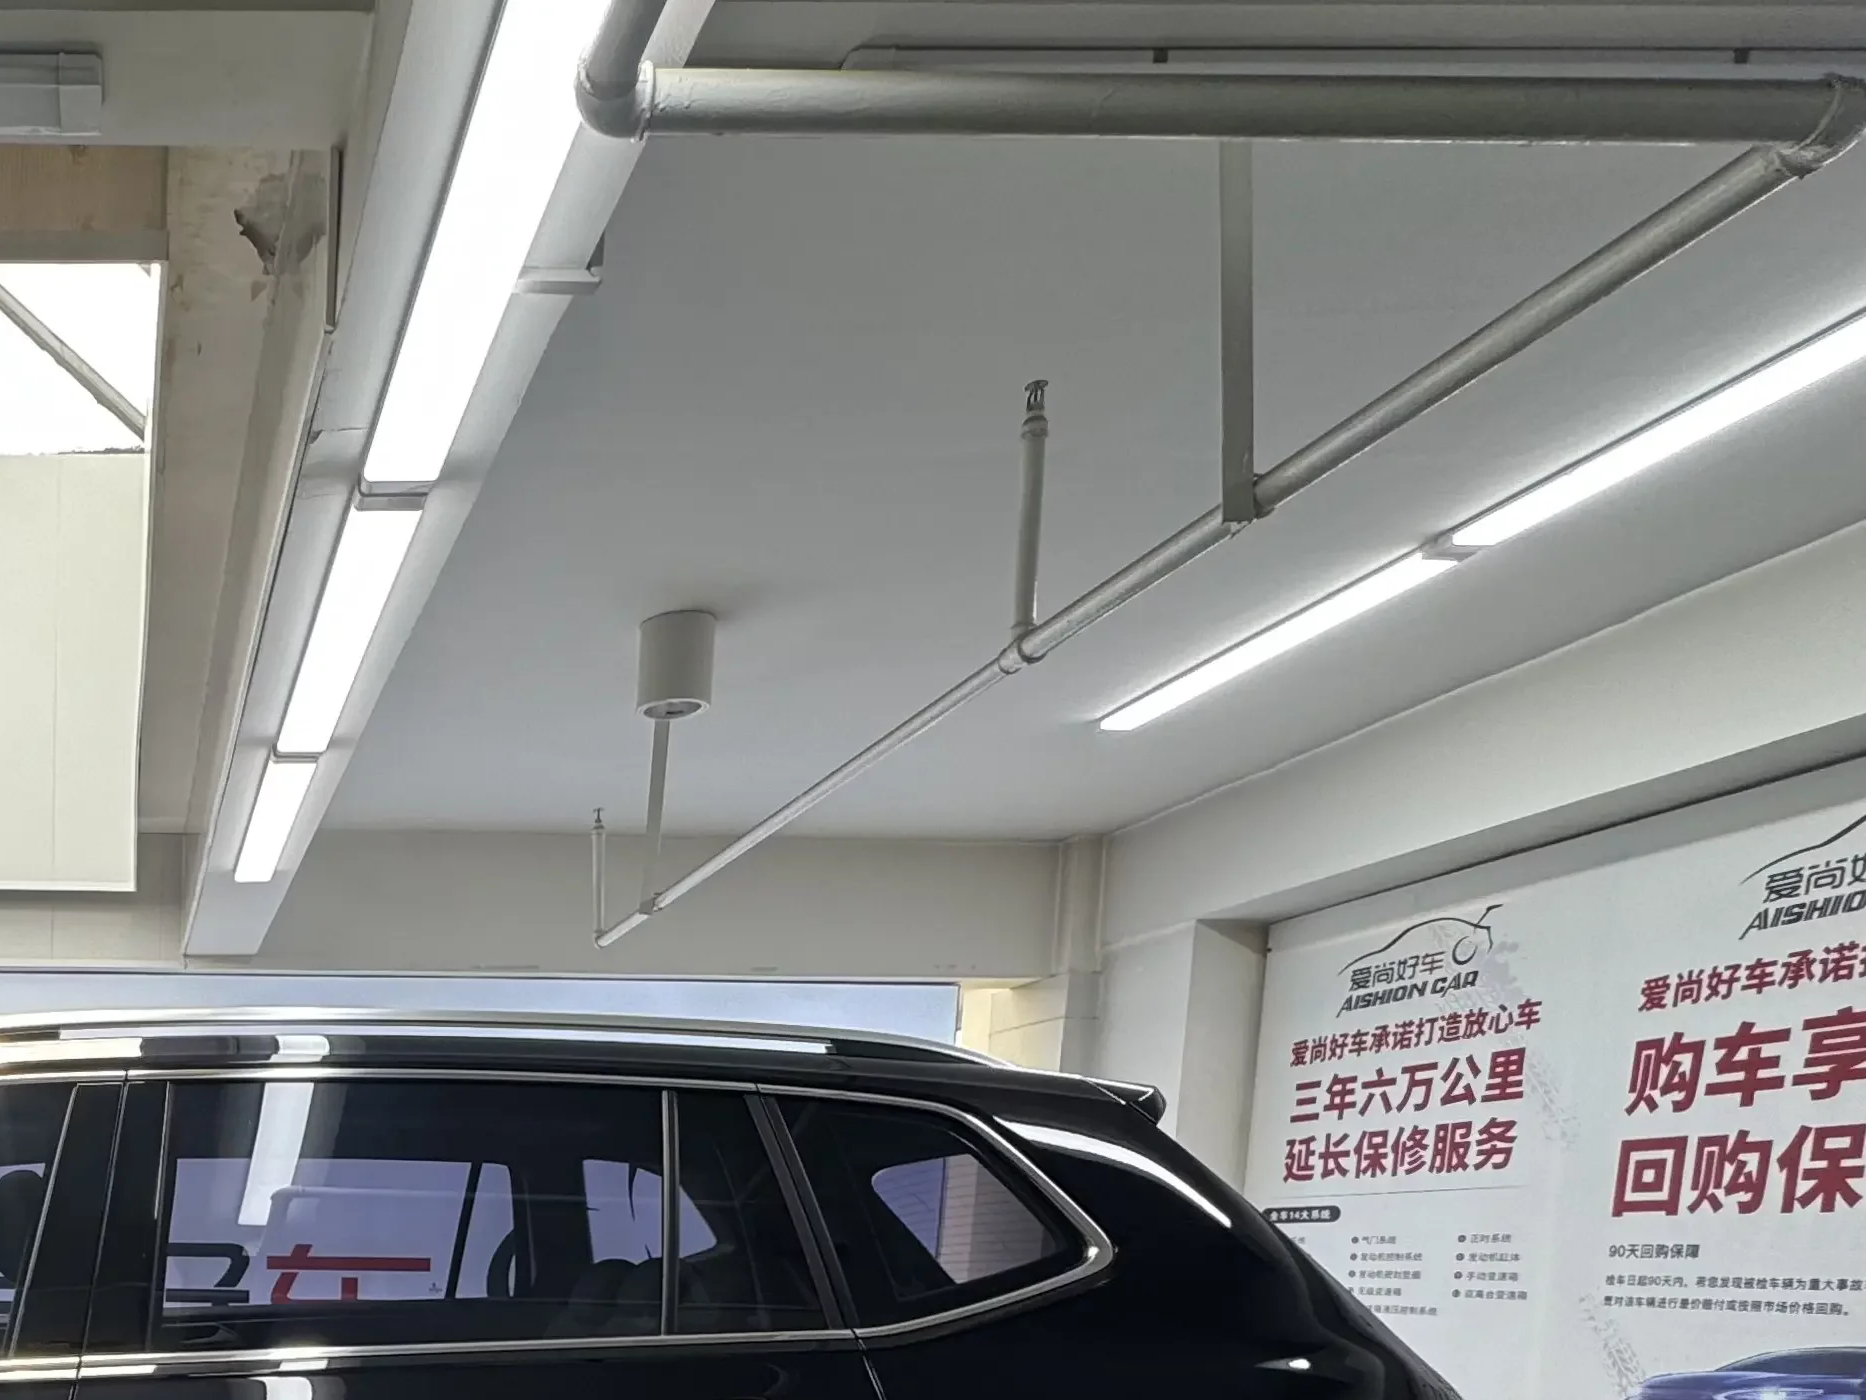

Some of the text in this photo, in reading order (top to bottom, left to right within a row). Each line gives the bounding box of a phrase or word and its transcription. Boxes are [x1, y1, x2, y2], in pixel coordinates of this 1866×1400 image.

[1336, 970, 1480, 1018] AISHION CAR
[1348, 951, 1447, 992] 爱尚好车
[1638, 941, 1866, 1012] 爱尚好车承诺
[1290, 998, 1543, 1067] 爱尚好车承诺打造放心车
[1624, 1006, 1866, 1116] 购车享
[1290, 1047, 1526, 1123] 三年六万公里
[1283, 1117, 1518, 1183] 延长保修服务
[1611, 1124, 1866, 1217] 回购保
[1608, 1244, 1700, 1259] 90天回购保障
